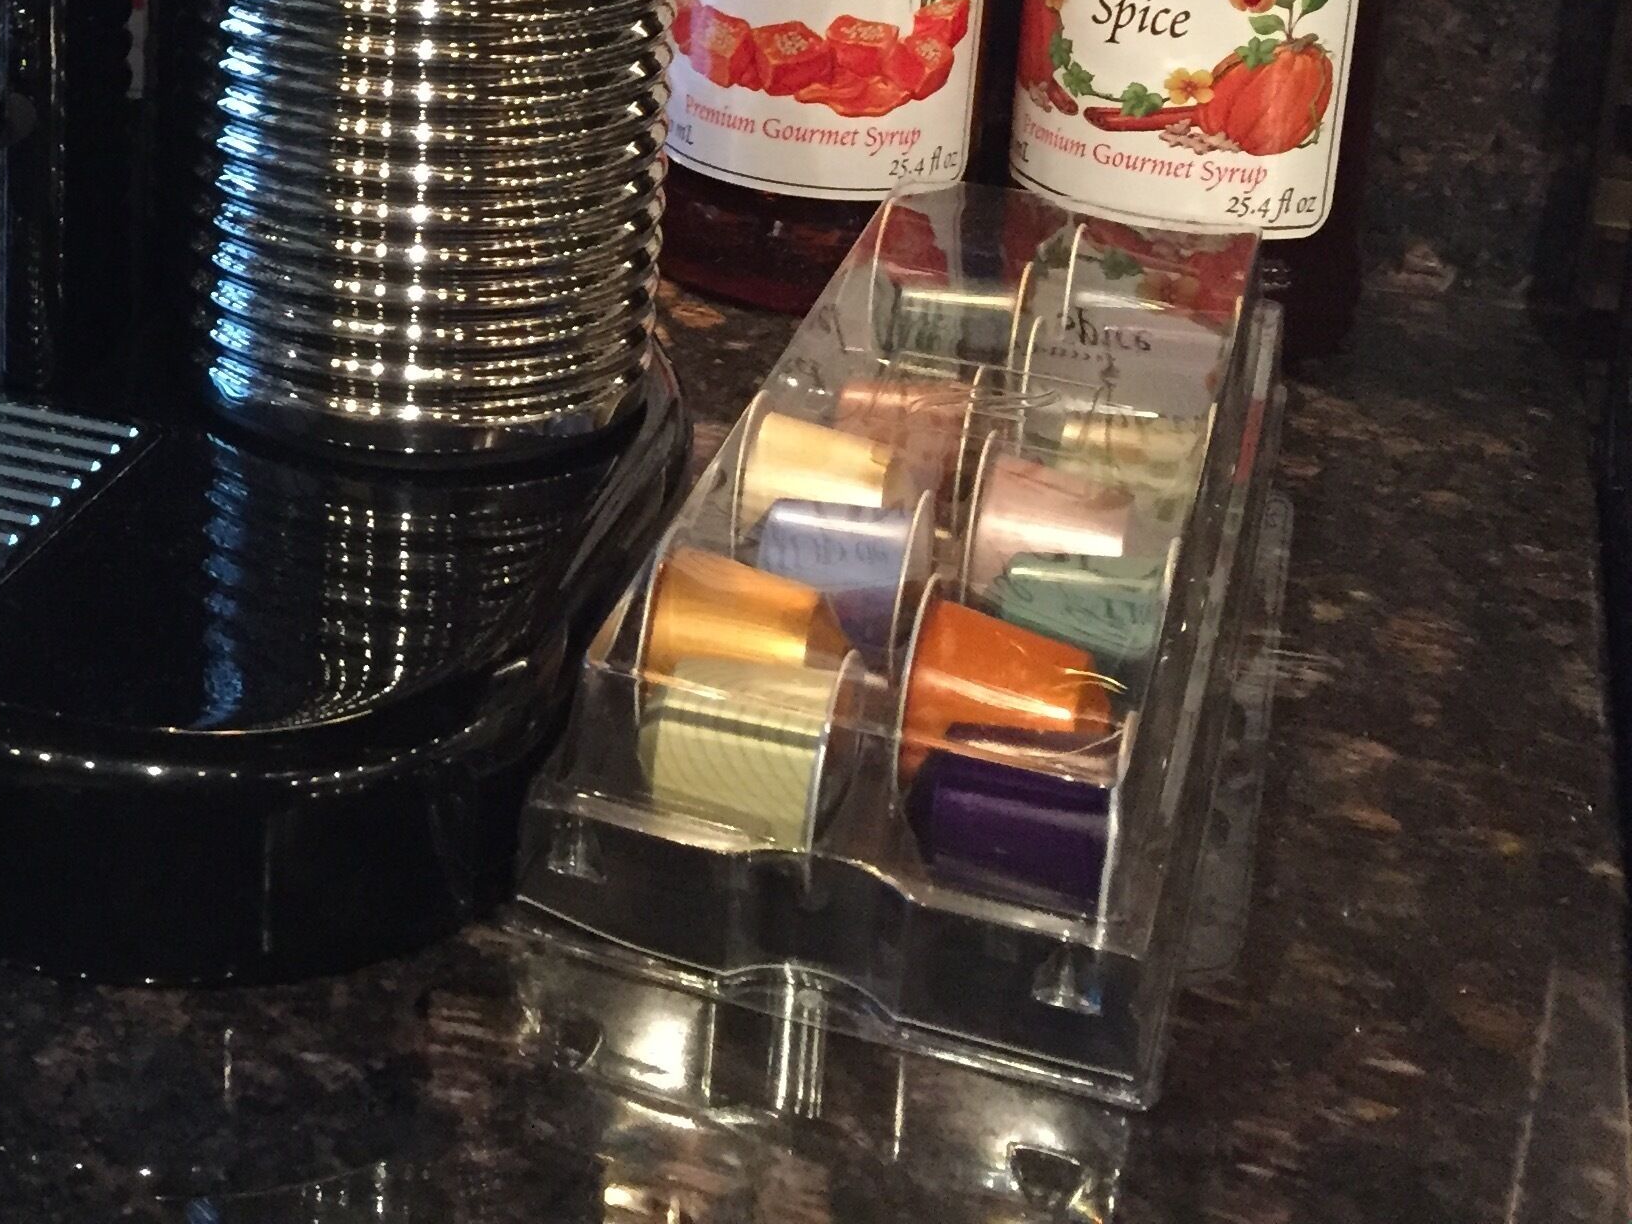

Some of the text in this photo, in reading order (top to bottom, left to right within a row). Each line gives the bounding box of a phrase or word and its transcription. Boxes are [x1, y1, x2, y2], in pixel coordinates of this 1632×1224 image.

[686, 93, 755, 134] Premium
[762, 118, 859, 147] Gourmet
[864, 126, 922, 157] Syrup
[889, 155, 924, 178] 25.4
[1024, 114, 1269, 193] Premium Gourmet Syrup
[1225, 187, 1318, 223] 25.4 fl oz
